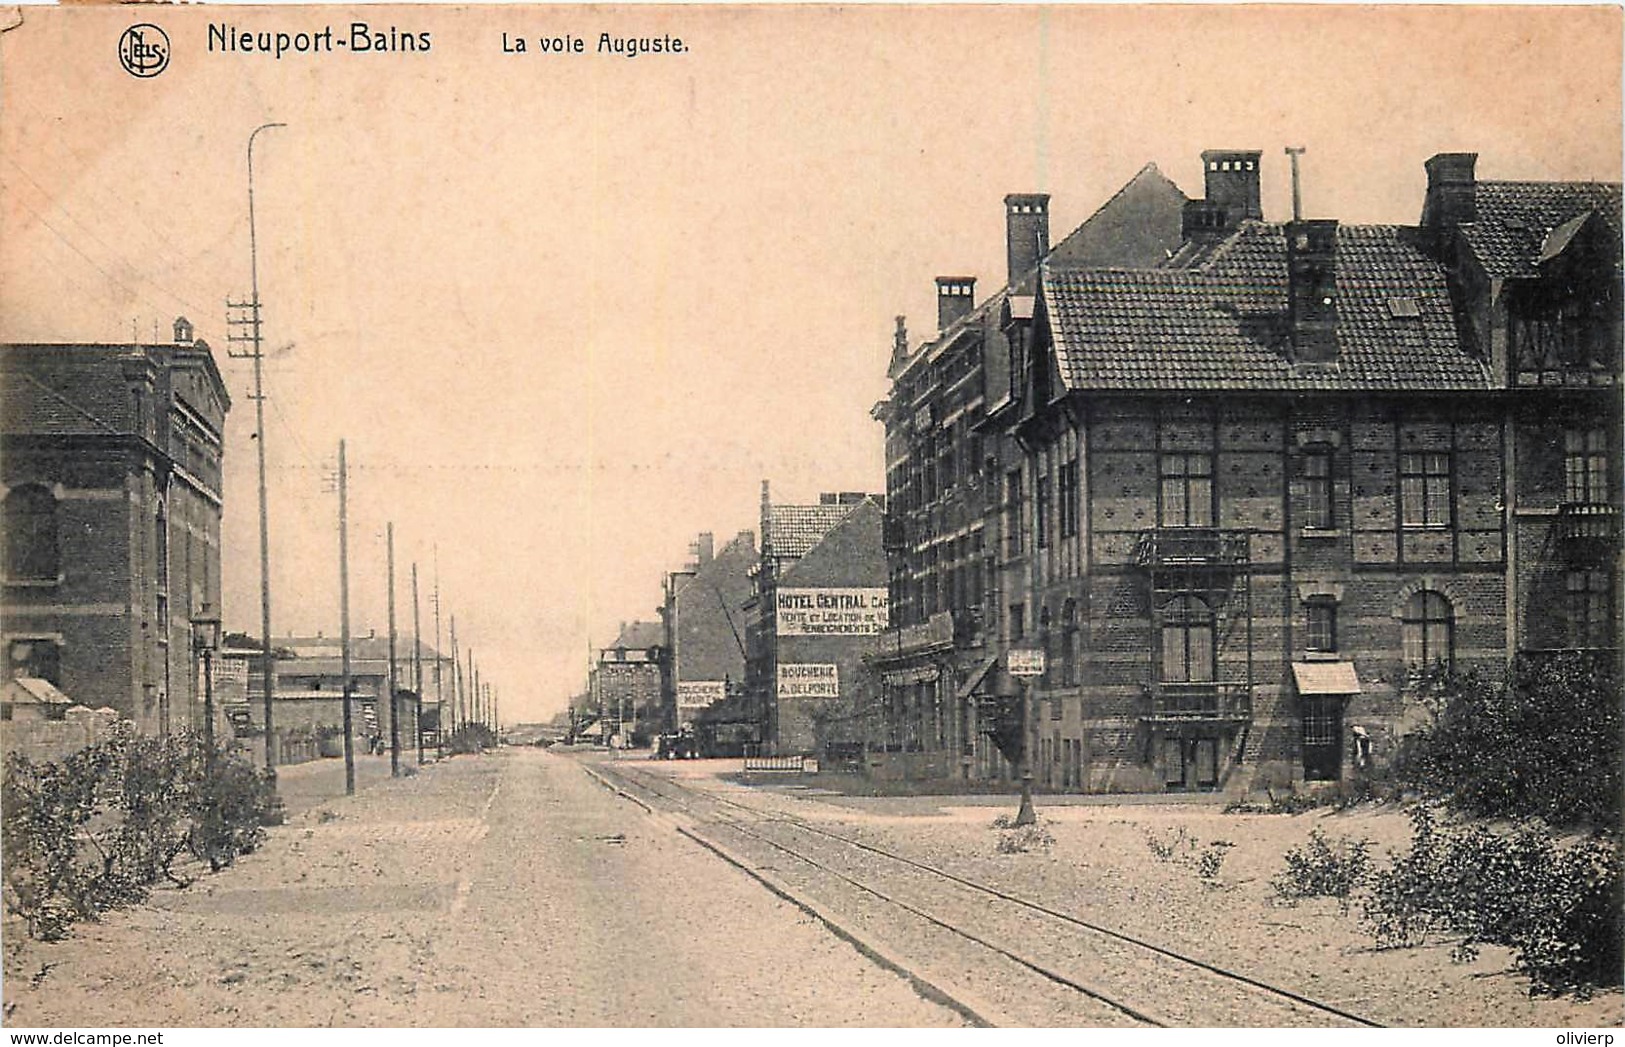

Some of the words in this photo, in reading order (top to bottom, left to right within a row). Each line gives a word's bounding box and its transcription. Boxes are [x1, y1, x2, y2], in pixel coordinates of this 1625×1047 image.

[208, 23, 431, 59] Nieuport-Bains
[502, 33, 527, 53] La
[540, 35, 584, 53] voie
[597, 33, 689, 58] Auguste.
[778, 594, 814, 609] HOTEL
[816, 593, 867, 609] CENTRAL
[782, 666, 834, 678] BOUCHERIE
